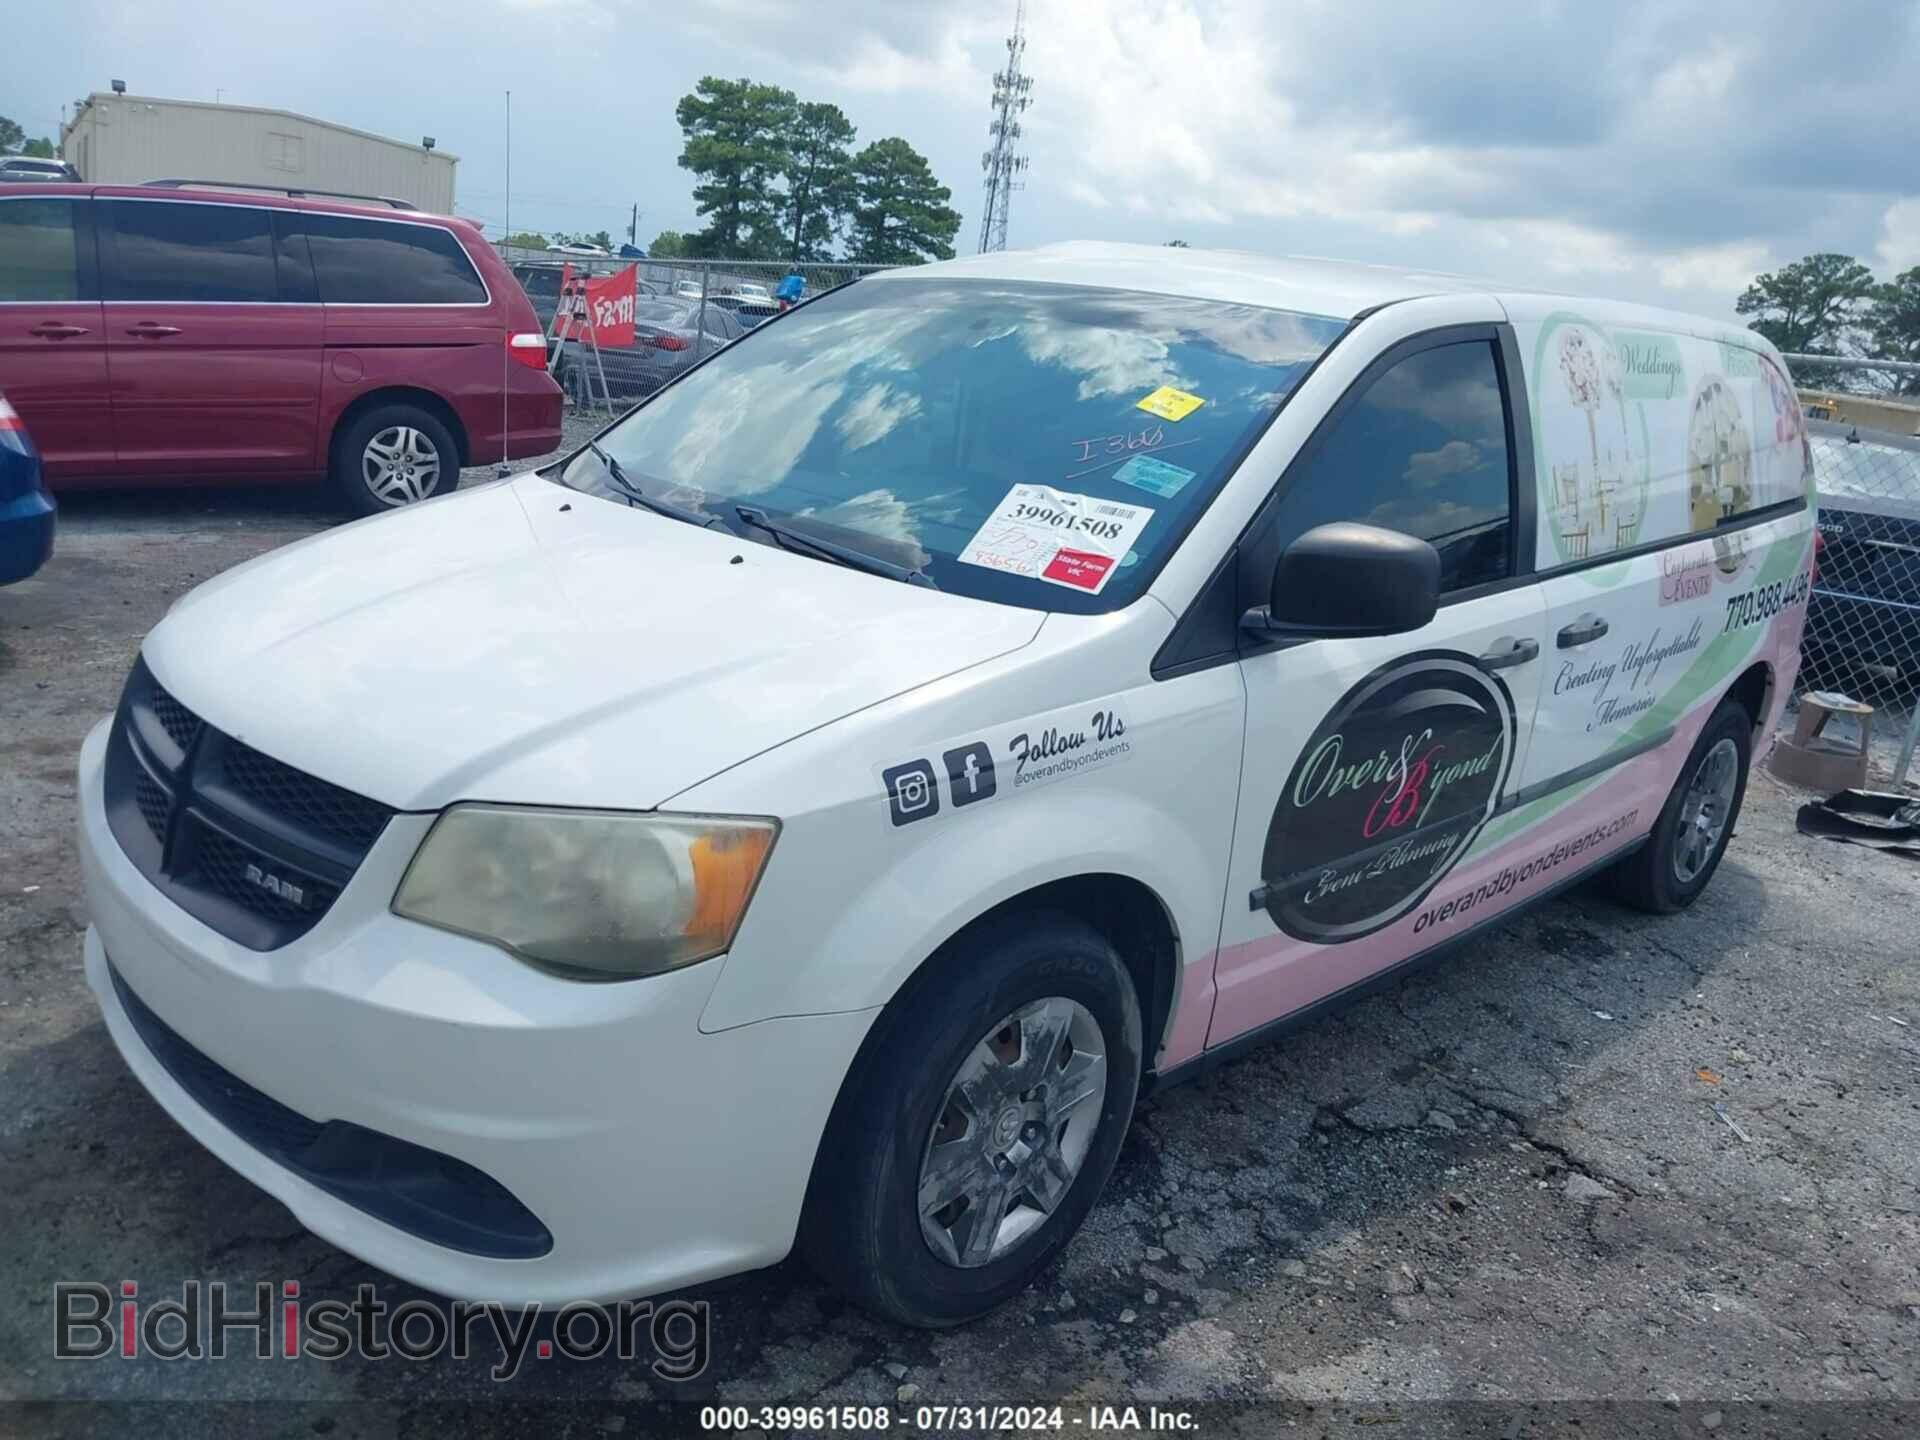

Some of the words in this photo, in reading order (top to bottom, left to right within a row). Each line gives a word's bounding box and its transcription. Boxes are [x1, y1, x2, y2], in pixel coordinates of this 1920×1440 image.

[1621, 344, 1682, 398] Weddings
[1008, 503, 1123, 539] 39961508
[1081, 558, 1106, 572] Farm
[1554, 660, 1616, 696] Creating
[1622, 615, 1704, 691] Unforgettable
[1009, 727, 1086, 774] Follow
[1091, 710, 1127, 741] Us
[1013, 741, 1130, 787] @overandbyondevents
[246, 863, 304, 905] RAM
[1413, 808, 1639, 934] overandbyondevents.com
